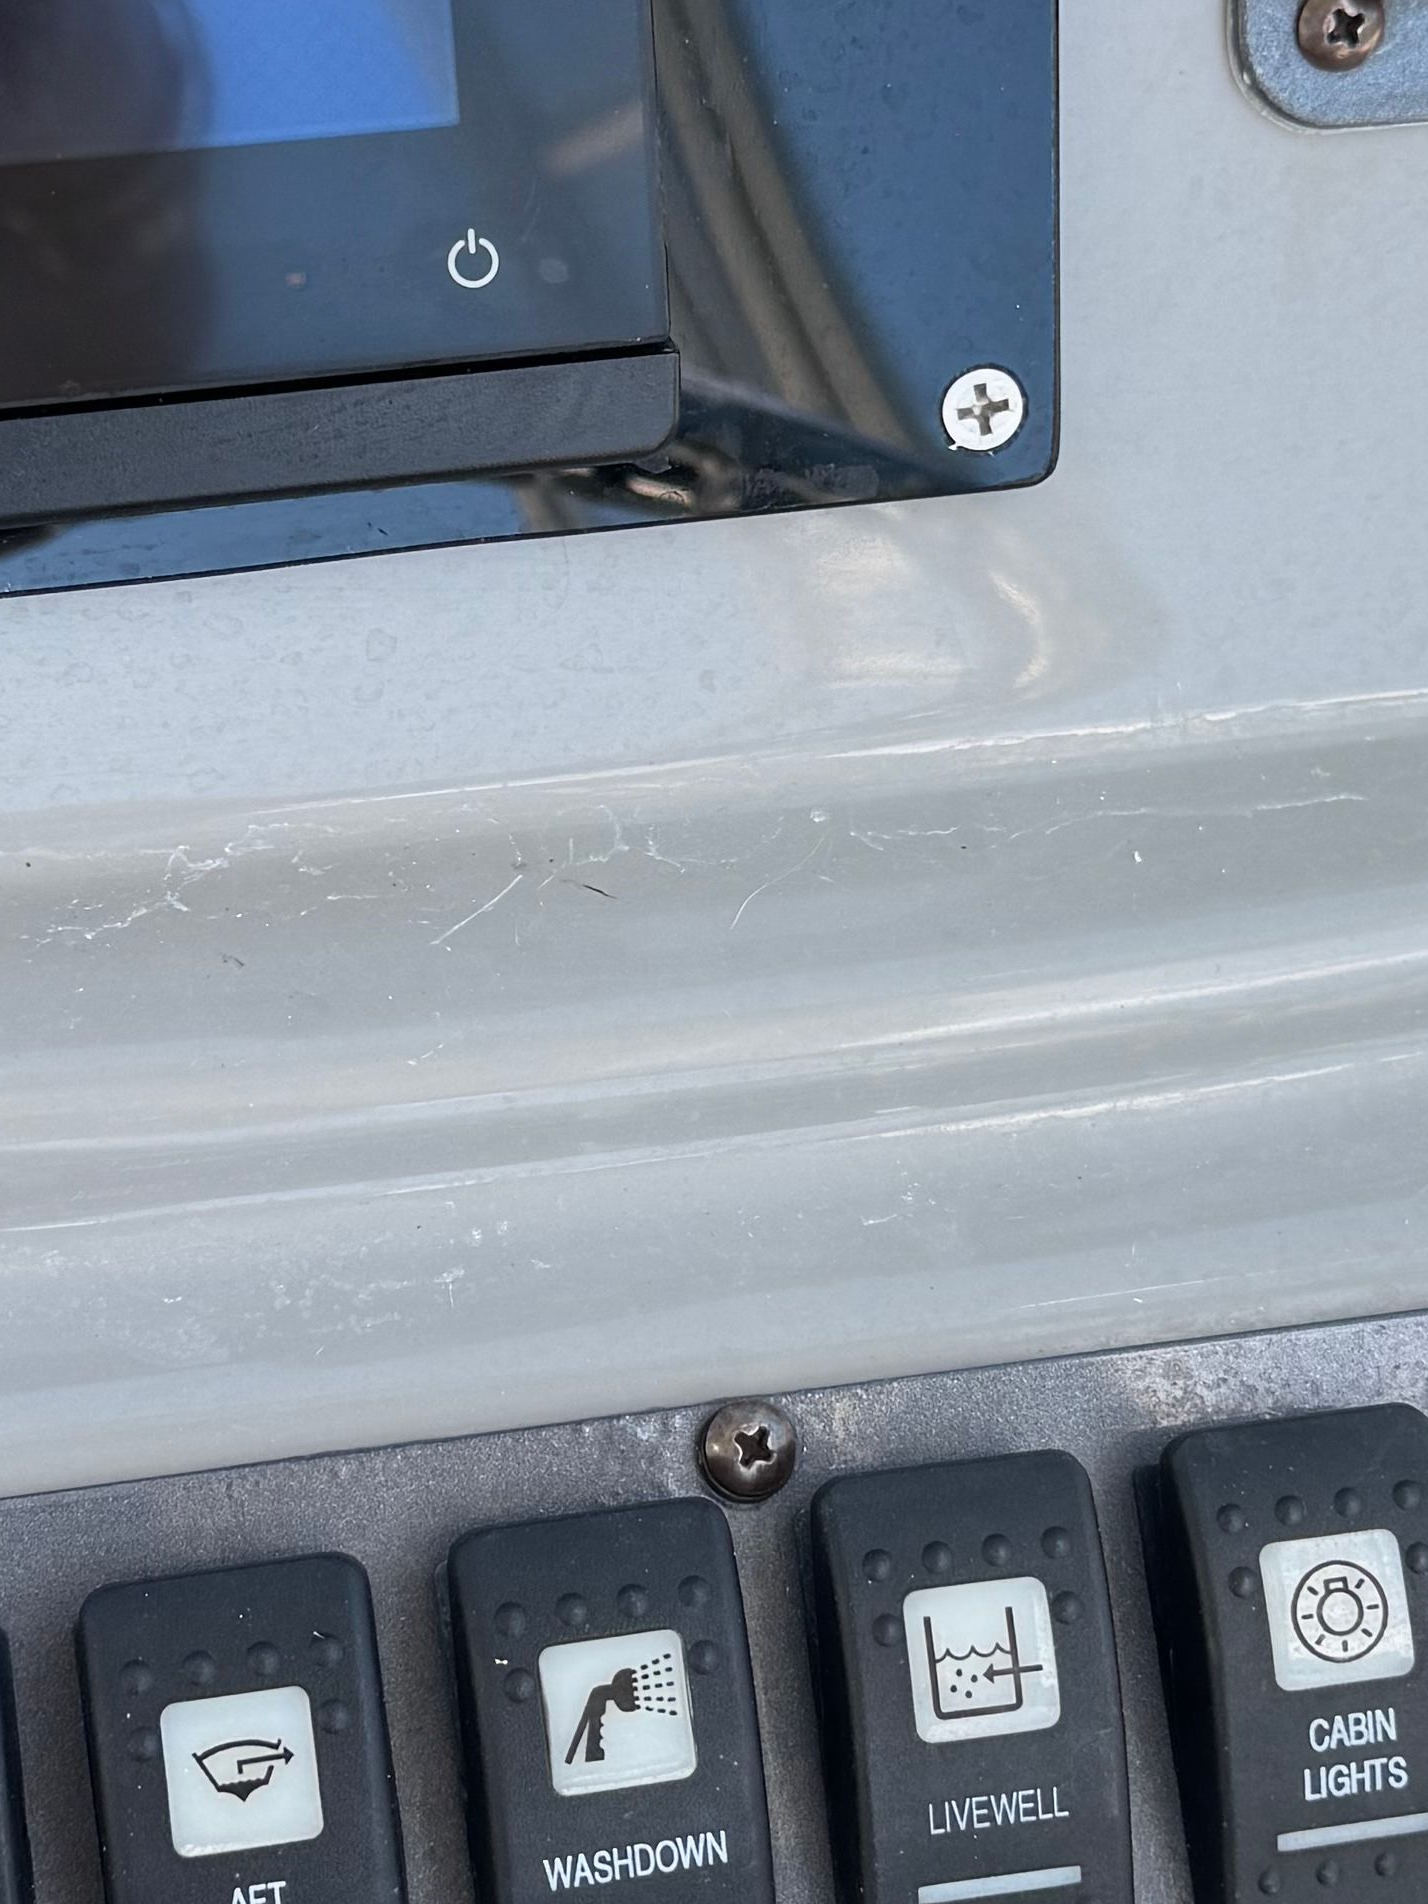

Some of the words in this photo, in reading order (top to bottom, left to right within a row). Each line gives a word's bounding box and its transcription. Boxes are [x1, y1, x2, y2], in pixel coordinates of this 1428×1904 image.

[1310, 1708, 1396, 1752] CABIN
[1304, 1757, 1408, 1800] LIGHTS
[929, 1787, 1069, 1834] LIVEWELL
[543, 1831, 727, 1891] WASHDOWN
